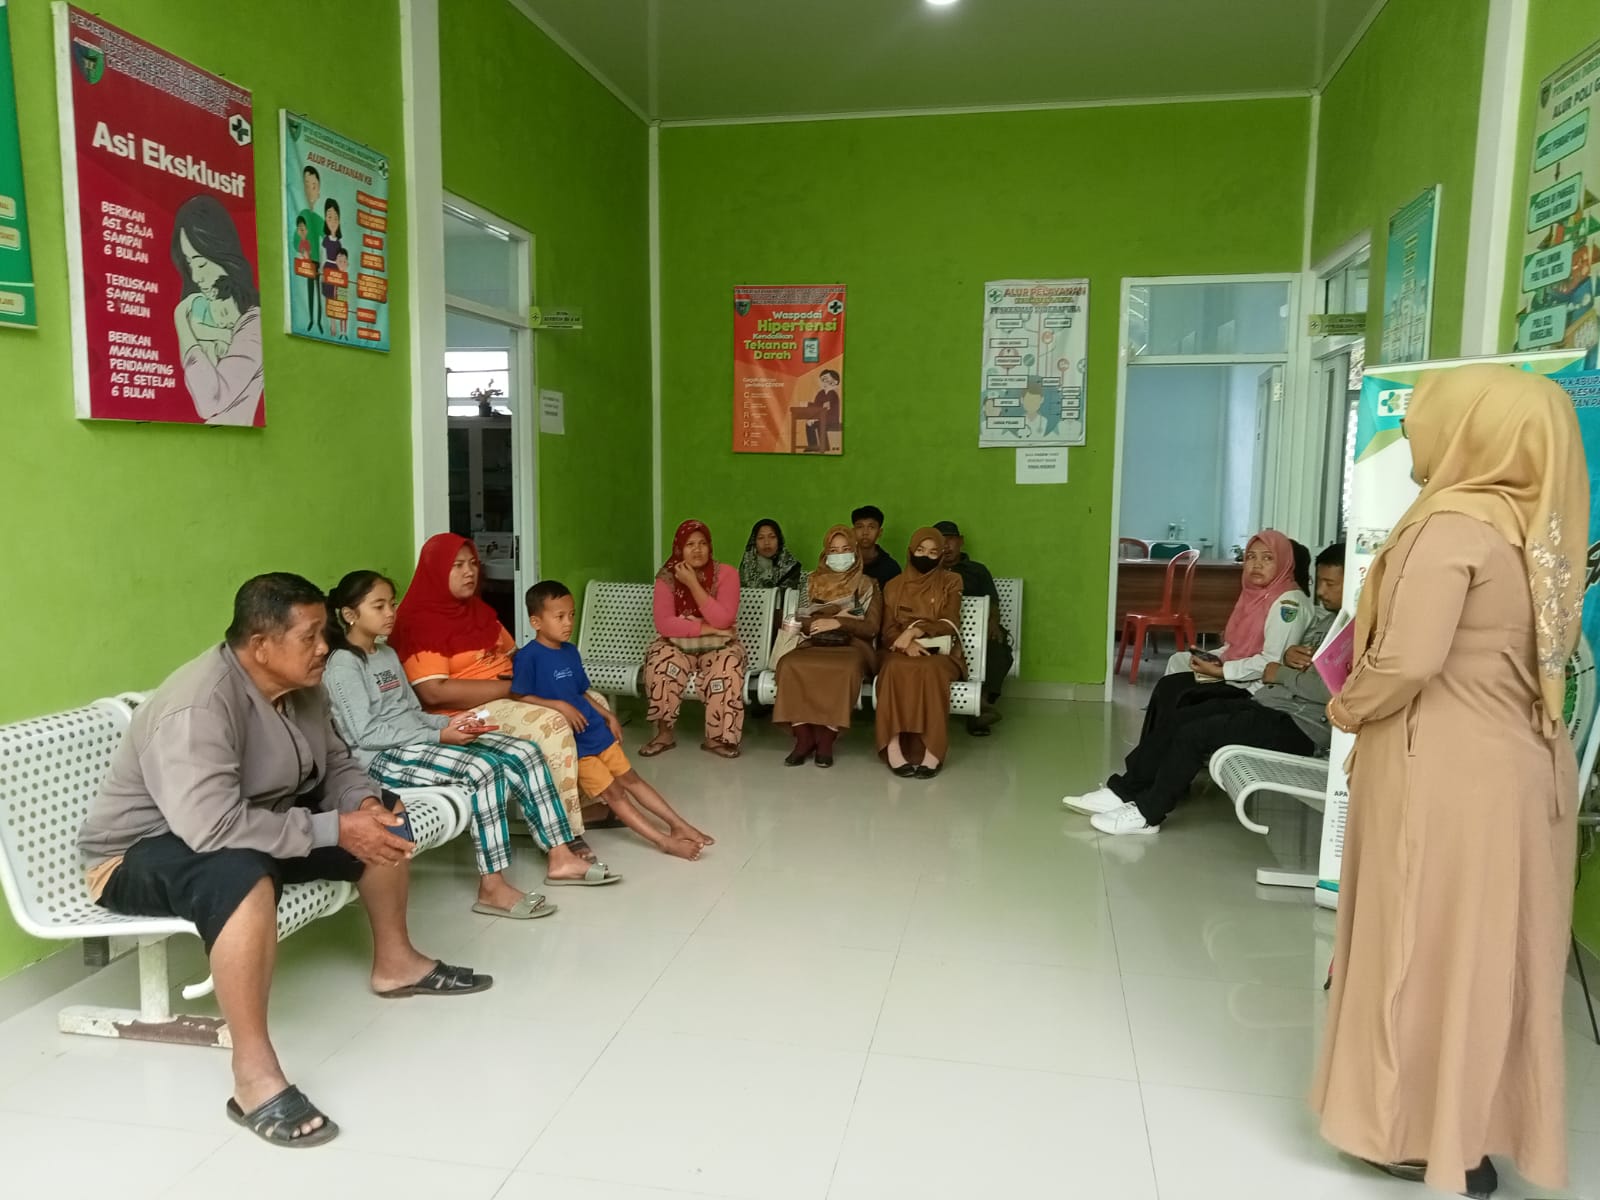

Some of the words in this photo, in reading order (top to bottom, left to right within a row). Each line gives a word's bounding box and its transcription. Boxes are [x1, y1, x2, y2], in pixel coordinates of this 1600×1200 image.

[92, 121, 136, 160] Asi
[142, 138, 246, 198] Eksklusif
[101, 201, 145, 223] BERIKAN
[102, 216, 122, 231] ASI
[126, 221, 154, 239] SAJA
[103, 231, 142, 249] SAMPAI
[104, 244, 112, 256] 6
[116, 247, 149, 264] BULAN
[105, 273, 158, 294] TERUSKAN
[105, 288, 145, 304] SAMPAI
[106, 300, 115, 312] 2
[119, 302, 150, 318] TAHUN
[772, 310, 822, 320] Waspadai
[757, 318, 837, 334] Hipertensi
[108, 331, 151, 347] BERIKAN
[744, 340, 797, 350] Tekanan
[109, 345, 159, 361] MAKANAN
[754, 350, 791, 360] Darah
[110, 358, 174, 375] PENDAMPING
[111, 372, 132, 384] ASI
[133, 374, 175, 388] SETELAH
[111, 385, 119, 396] 6
[123, 386, 155, 399] BULAN
